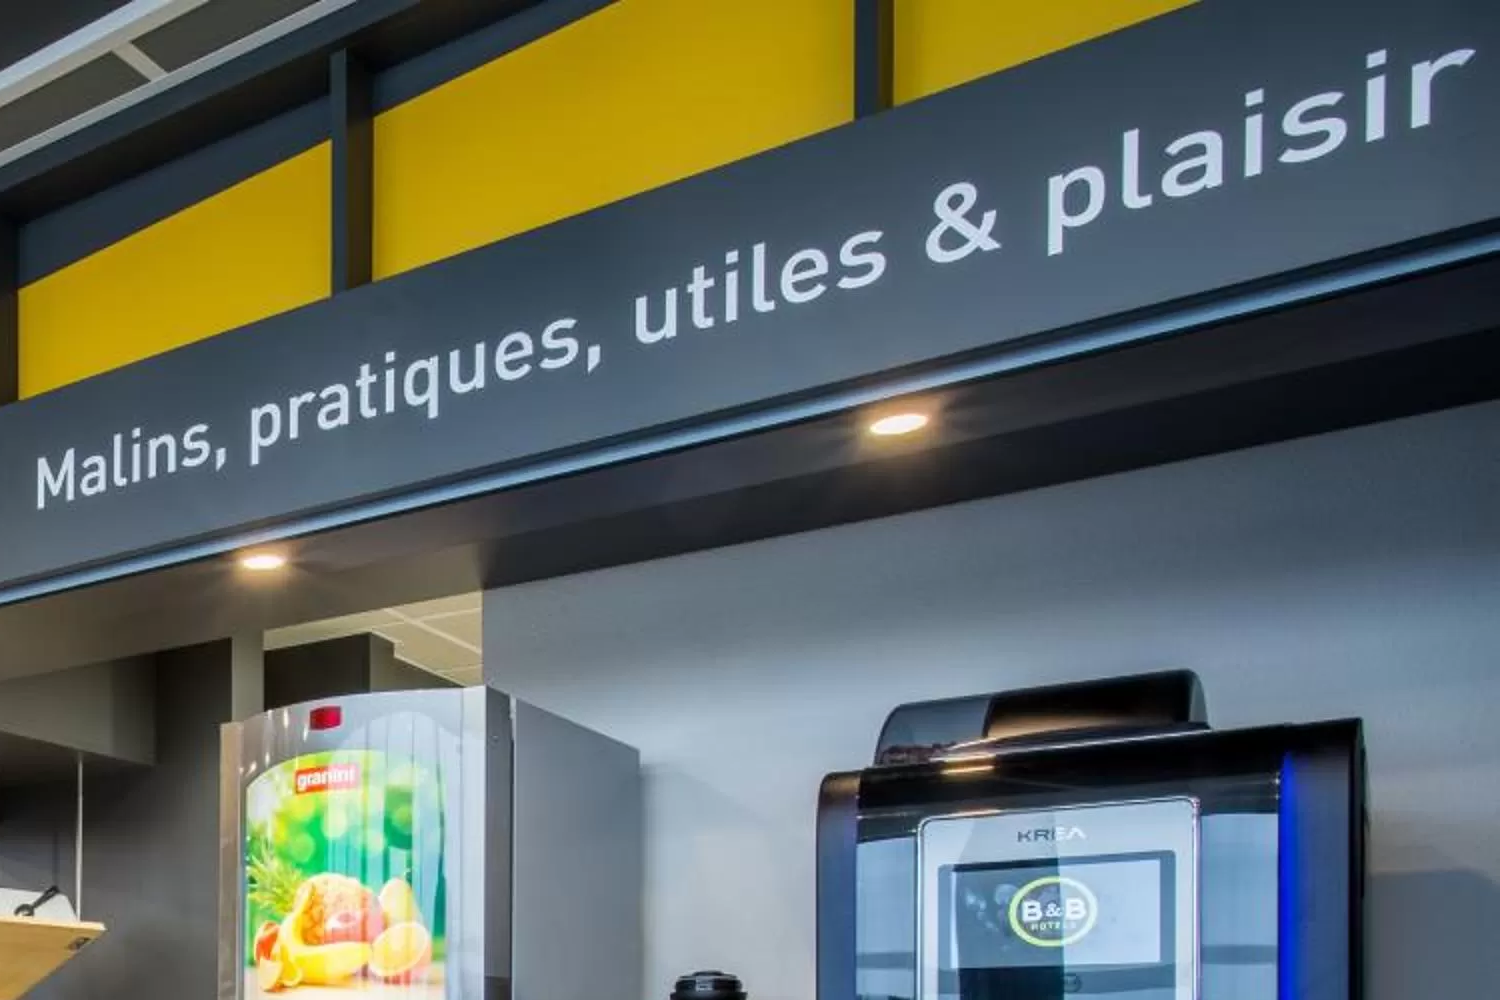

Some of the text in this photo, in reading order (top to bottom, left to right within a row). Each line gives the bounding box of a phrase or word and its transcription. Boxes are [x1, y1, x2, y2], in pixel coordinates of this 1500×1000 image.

[36, 48, 1476, 510] Malins, pratiques, utiles & plaisir
[298, 766, 354, 791] granini
